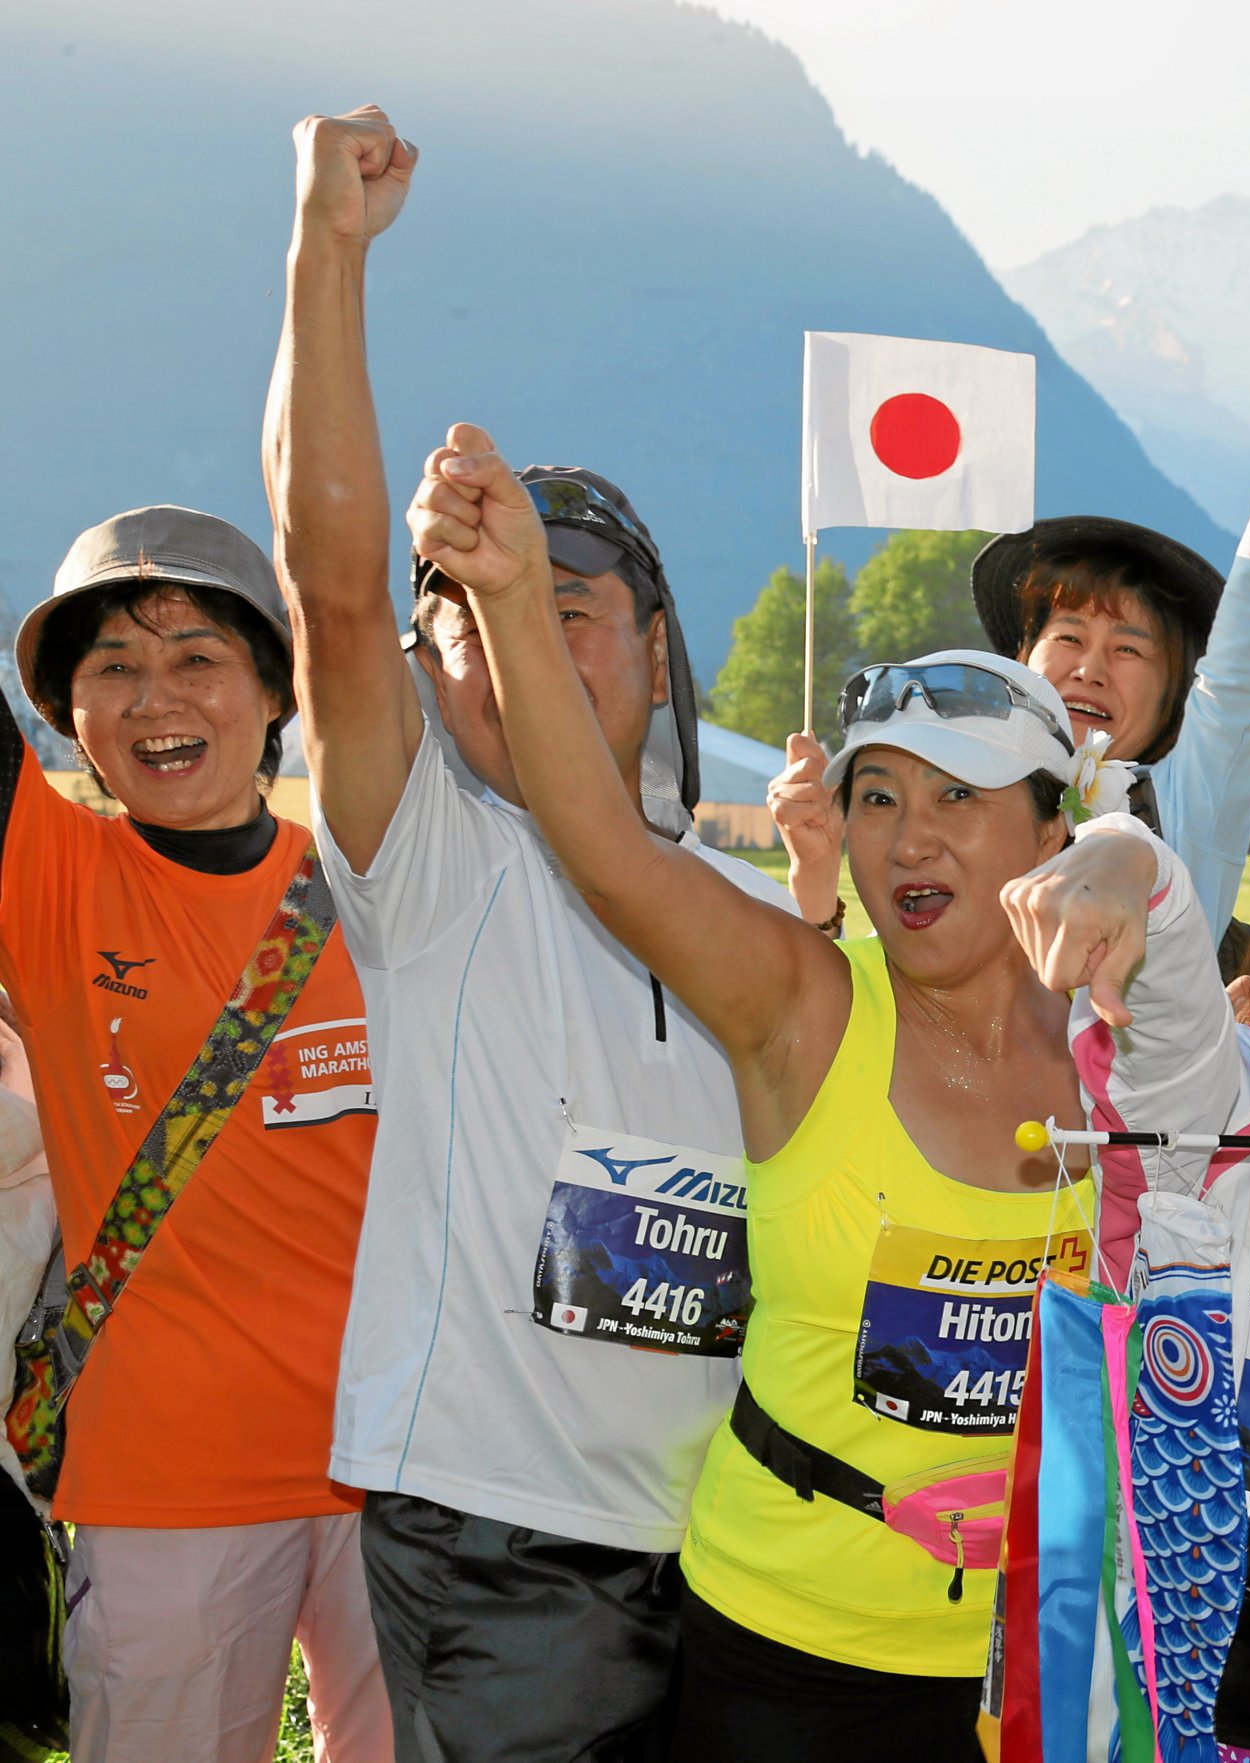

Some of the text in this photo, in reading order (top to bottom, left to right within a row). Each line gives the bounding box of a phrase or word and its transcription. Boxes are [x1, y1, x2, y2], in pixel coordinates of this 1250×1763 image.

[92, 973, 148, 1000] MIZUNO
[298, 1040, 369, 1062] ING AMS
[301, 1057, 371, 1079] MARATH
[654, 1167, 748, 1210] MIZU
[634, 1206, 728, 1260] Tohru
[926, 1254, 983, 1285] DIE
[621, 1278, 705, 1326] 4416
[597, 1317, 618, 1333] JPN
[624, 1323, 675, 1344] Yoshimiya
[676, 1331, 701, 1346] Tohru
[944, 1370, 1026, 1407] 4415
[920, 1409, 942, 1423] JPN
[950, 1412, 1006, 1428] Yoshimiya
